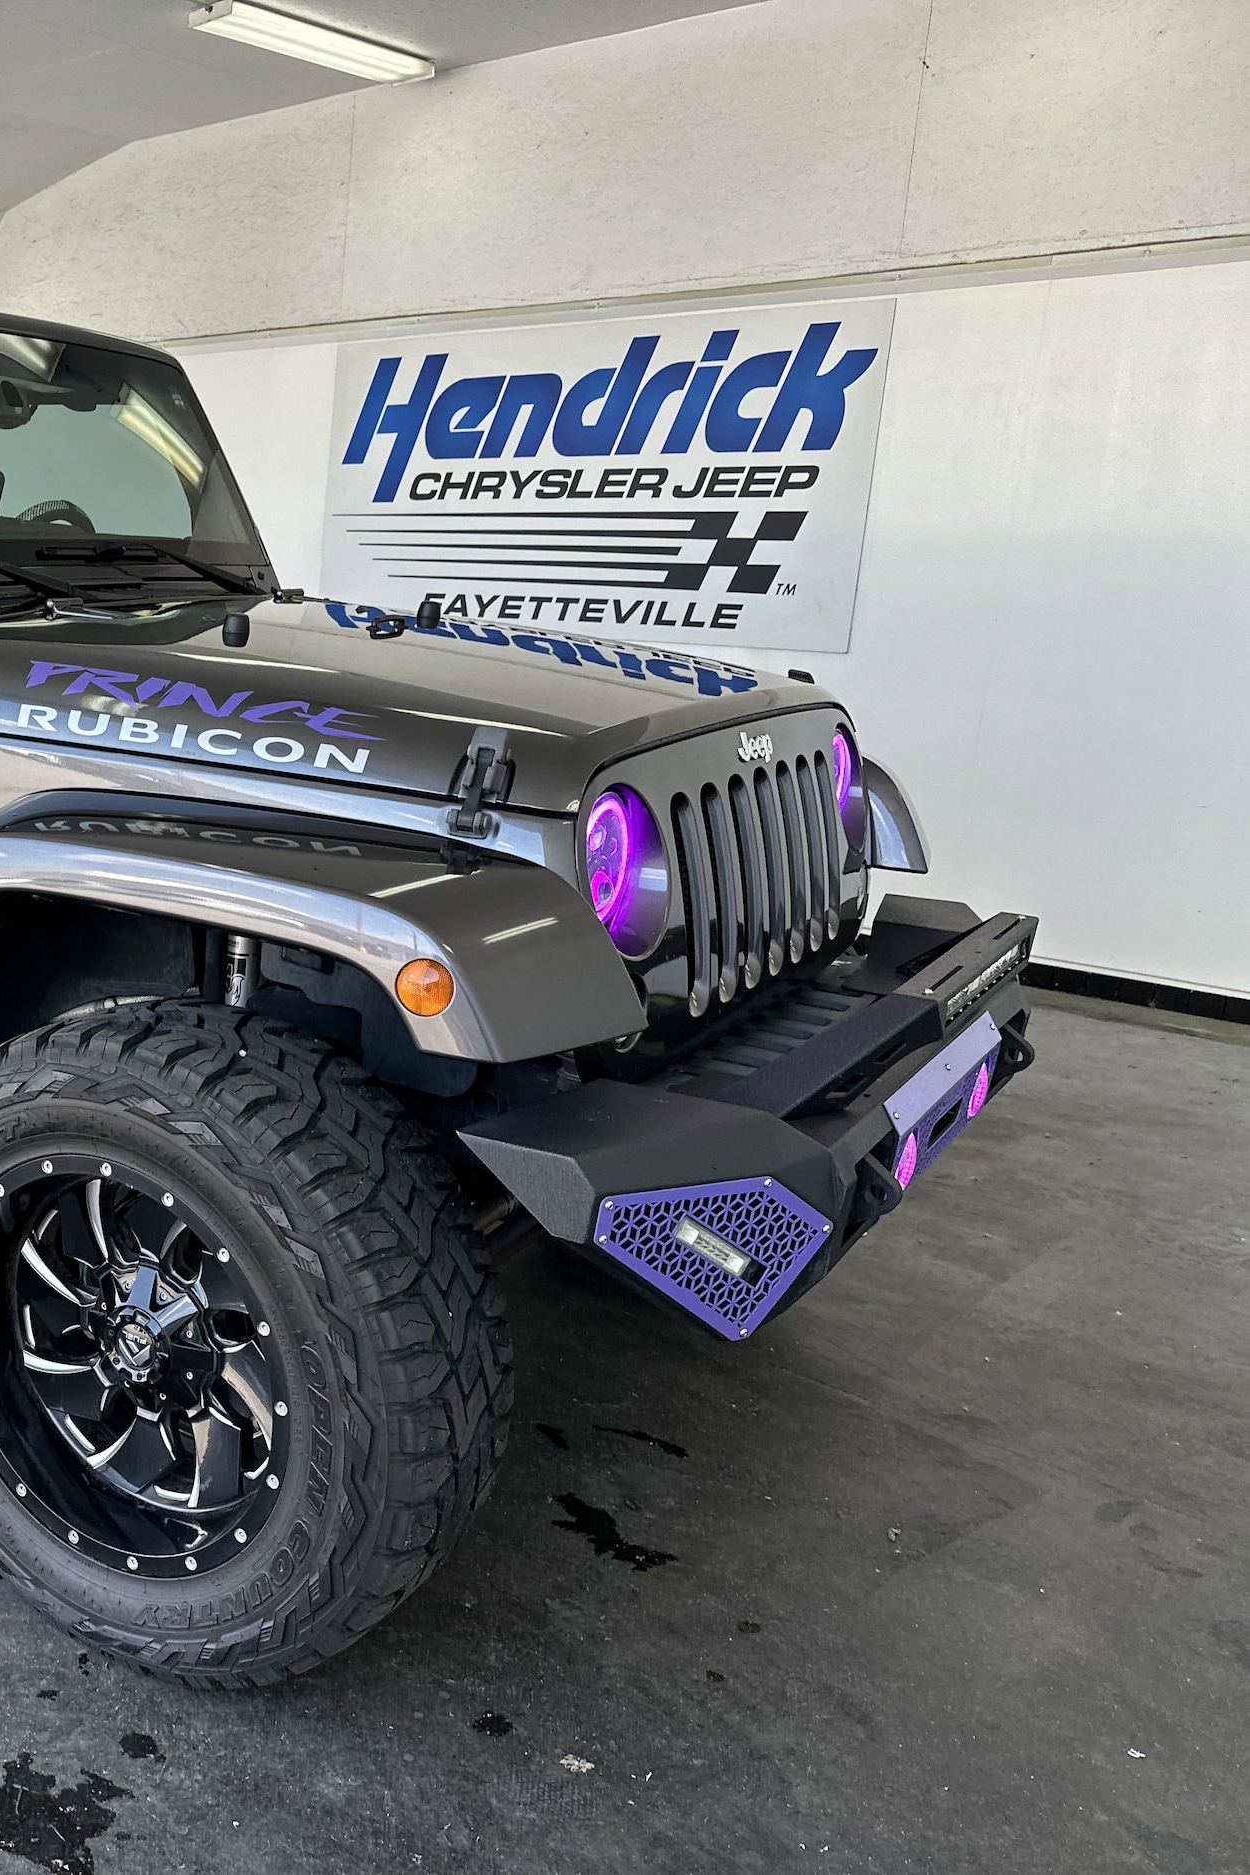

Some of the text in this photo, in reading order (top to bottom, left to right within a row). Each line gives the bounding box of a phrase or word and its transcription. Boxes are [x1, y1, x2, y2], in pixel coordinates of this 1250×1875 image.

[342, 321, 879, 503] Hendrick
[409, 464, 821, 501] CHRYSLER JEEP
[775, 583, 797, 596] TM
[25, 660, 388, 742] PRINCE
[16, 703, 371, 775] RUBICON
[737, 731, 774, 763] Jeep
[122, 1330, 148, 1345] FUEL
[132, 1344, 333, 1630] OPEN COUNTRY
